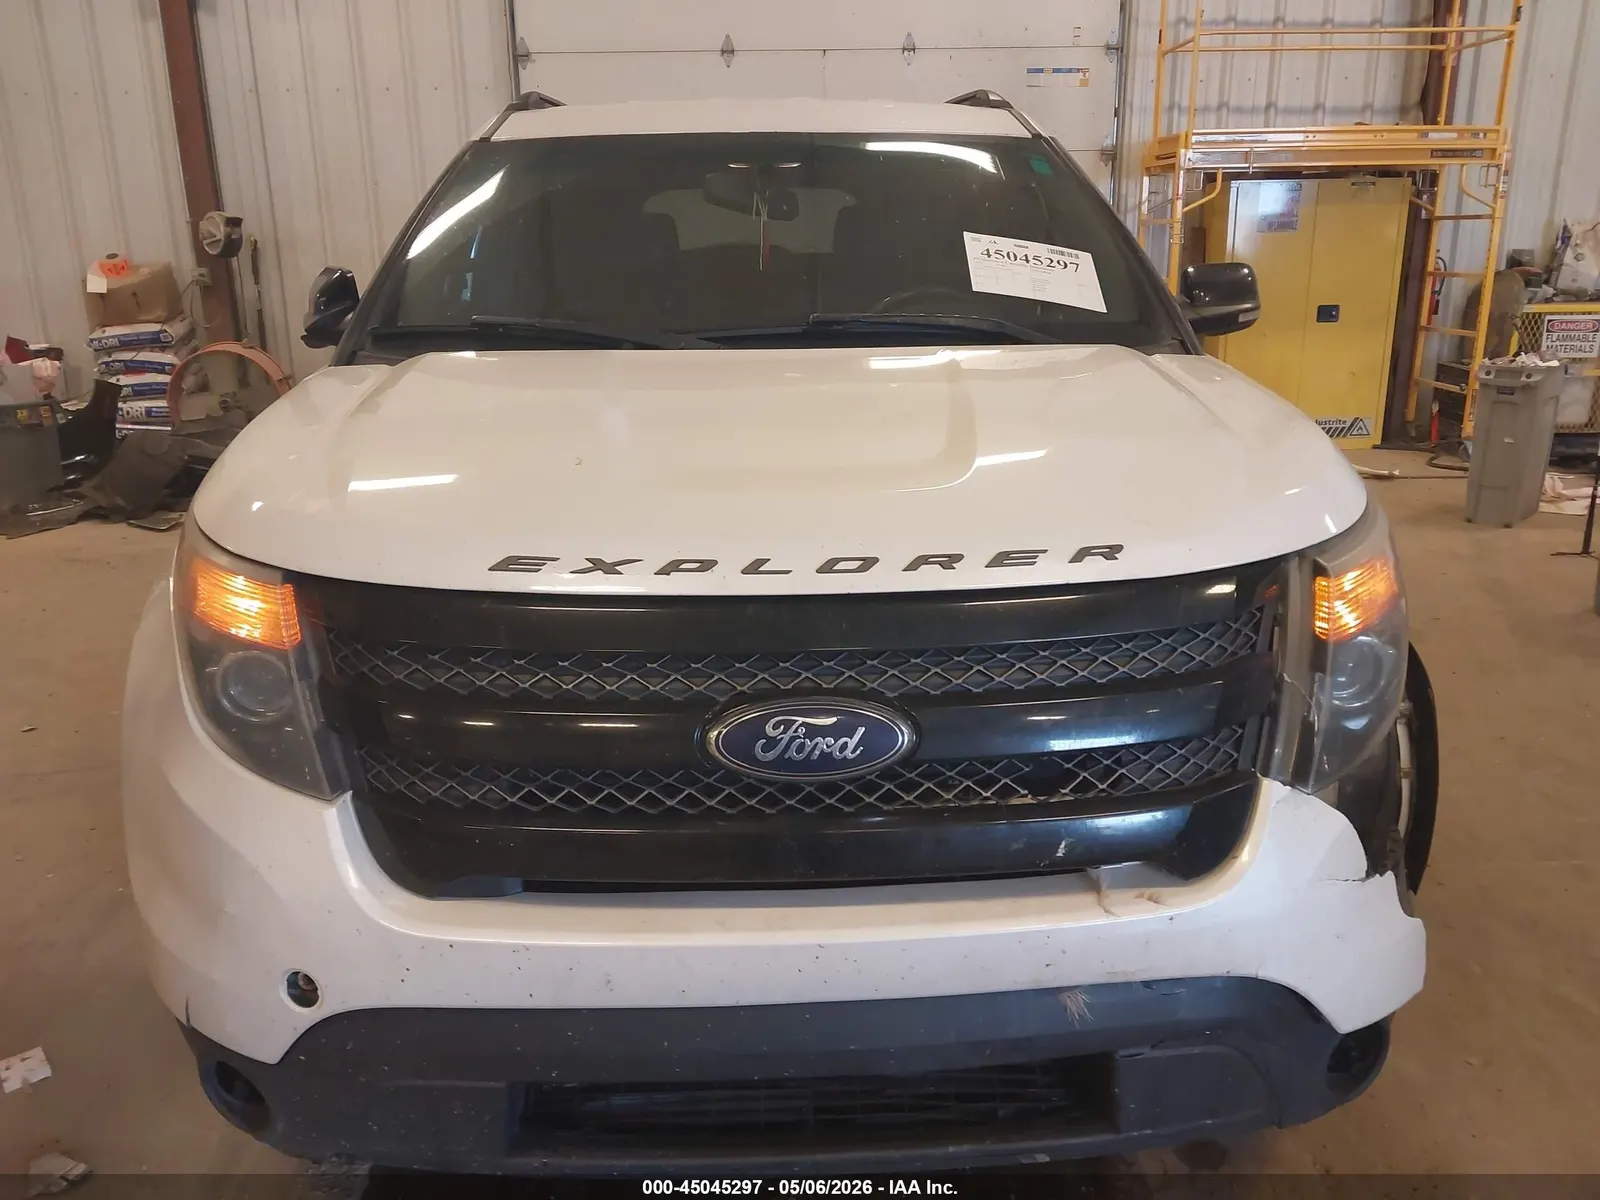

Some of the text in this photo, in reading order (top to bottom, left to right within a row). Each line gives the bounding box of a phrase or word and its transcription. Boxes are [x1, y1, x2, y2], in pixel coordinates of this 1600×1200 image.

[980, 247, 1080, 273] 45045297
[1546, 333, 1597, 343] FLAMMABLE
[1553, 322, 1593, 330] DANGER
[487, 543, 1125, 577] EXPLORER
[754, 715, 867, 762] Ford
